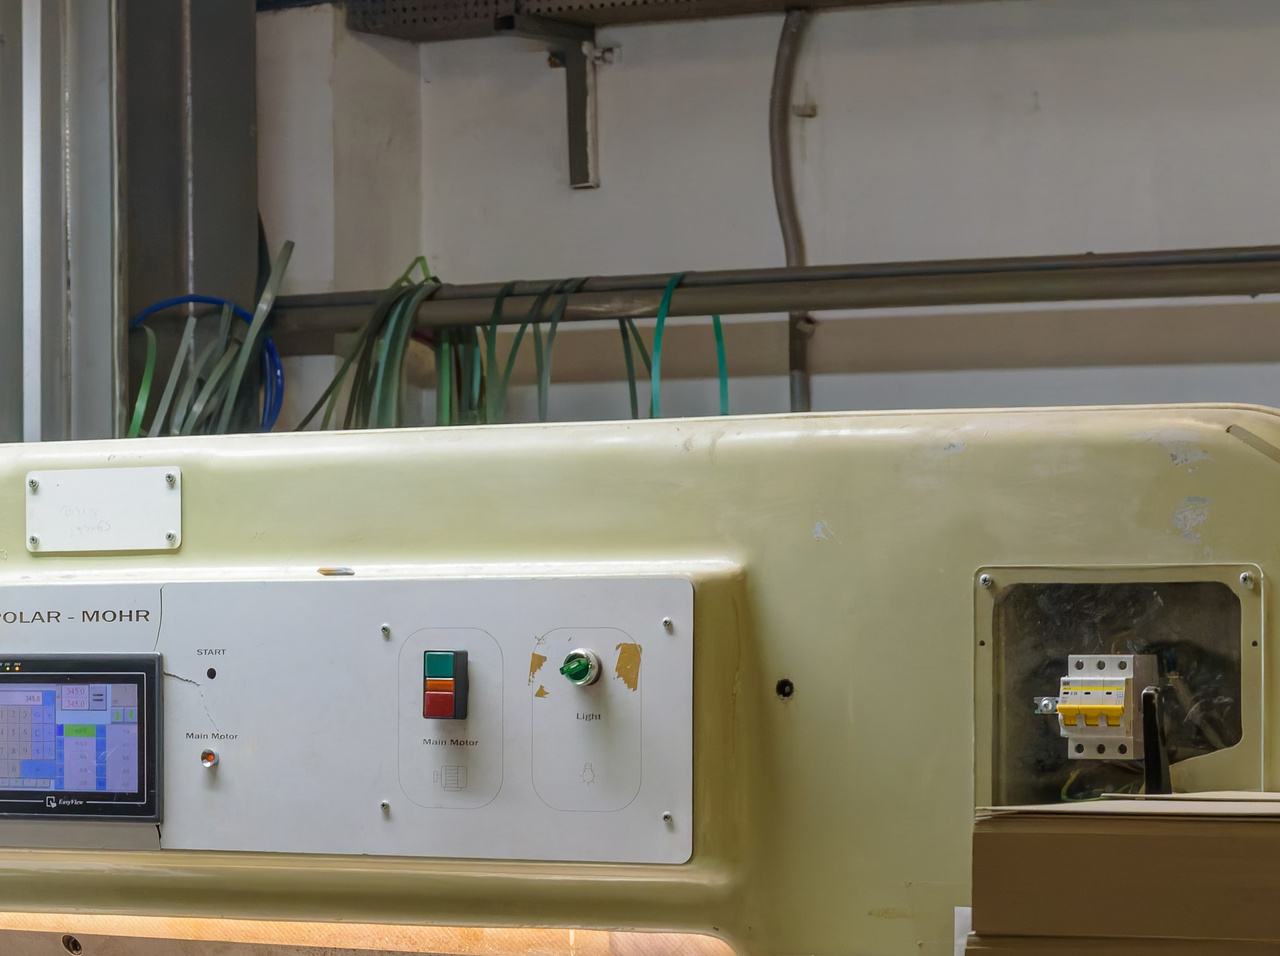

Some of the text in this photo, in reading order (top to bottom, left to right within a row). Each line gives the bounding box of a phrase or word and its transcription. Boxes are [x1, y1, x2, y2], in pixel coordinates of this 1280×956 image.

[81, 609, 150, 623] MOHR
[196, 648, 227, 656] START
[576, 712, 602, 722] Light
[185, 732, 239, 740] Main Motor
[422, 738, 479, 747] Main Motor
[58, 798, 84, 806] EasyView
